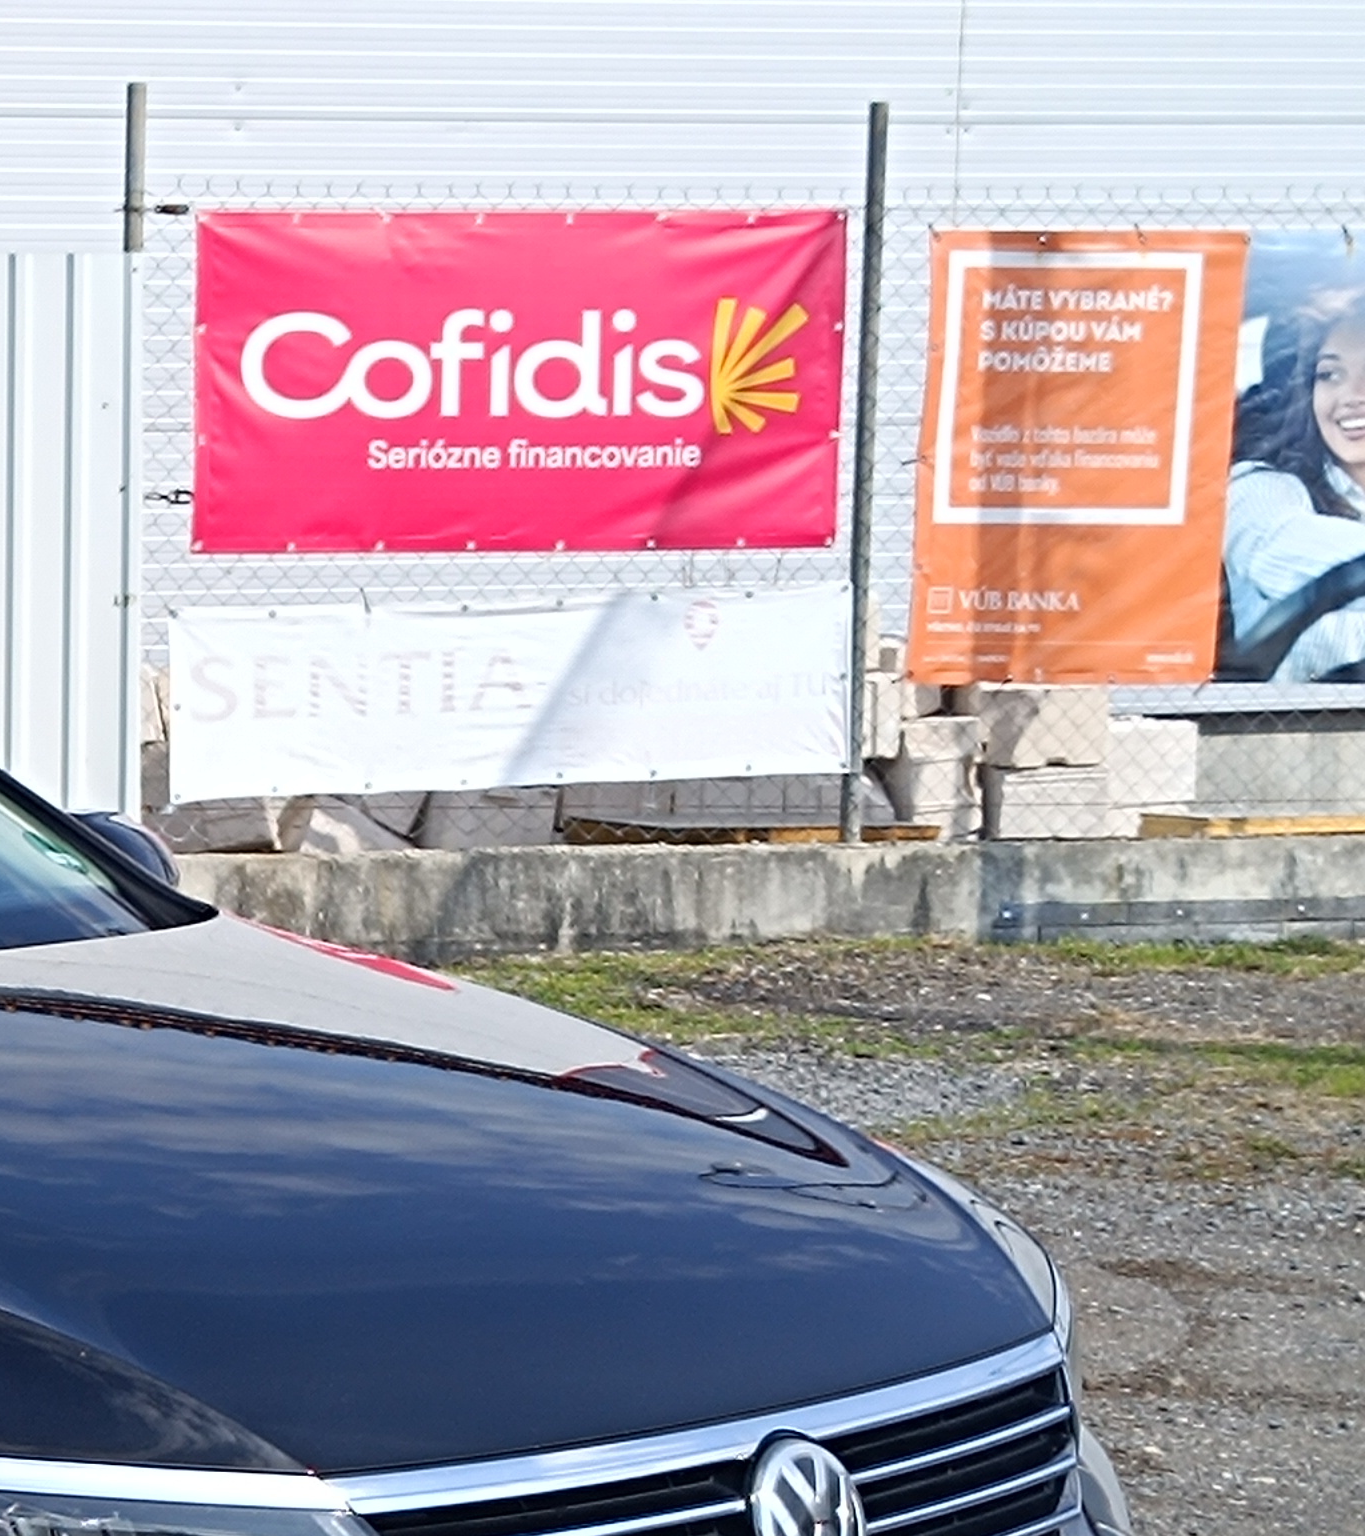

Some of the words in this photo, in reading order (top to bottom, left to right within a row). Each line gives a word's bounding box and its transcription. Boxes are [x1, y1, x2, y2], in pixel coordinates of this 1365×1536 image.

[981, 283, 1043, 311] MÁTE
[1048, 283, 1173, 312] VYBRANÉ?
[979, 320, 995, 342] S
[1001, 315, 1085, 342] KÚPOU
[1090, 315, 1142, 342] VÁM
[240, 307, 705, 420] Cofidis
[977, 345, 1114, 374] POMÔŽEME
[366, 438, 500, 470] Seriózne
[507, 438, 702, 470] financovanie
[958, 586, 1003, 611] VÚB
[1007, 590, 1081, 611] BANKA
[189, 649, 532, 723] SENTIA
